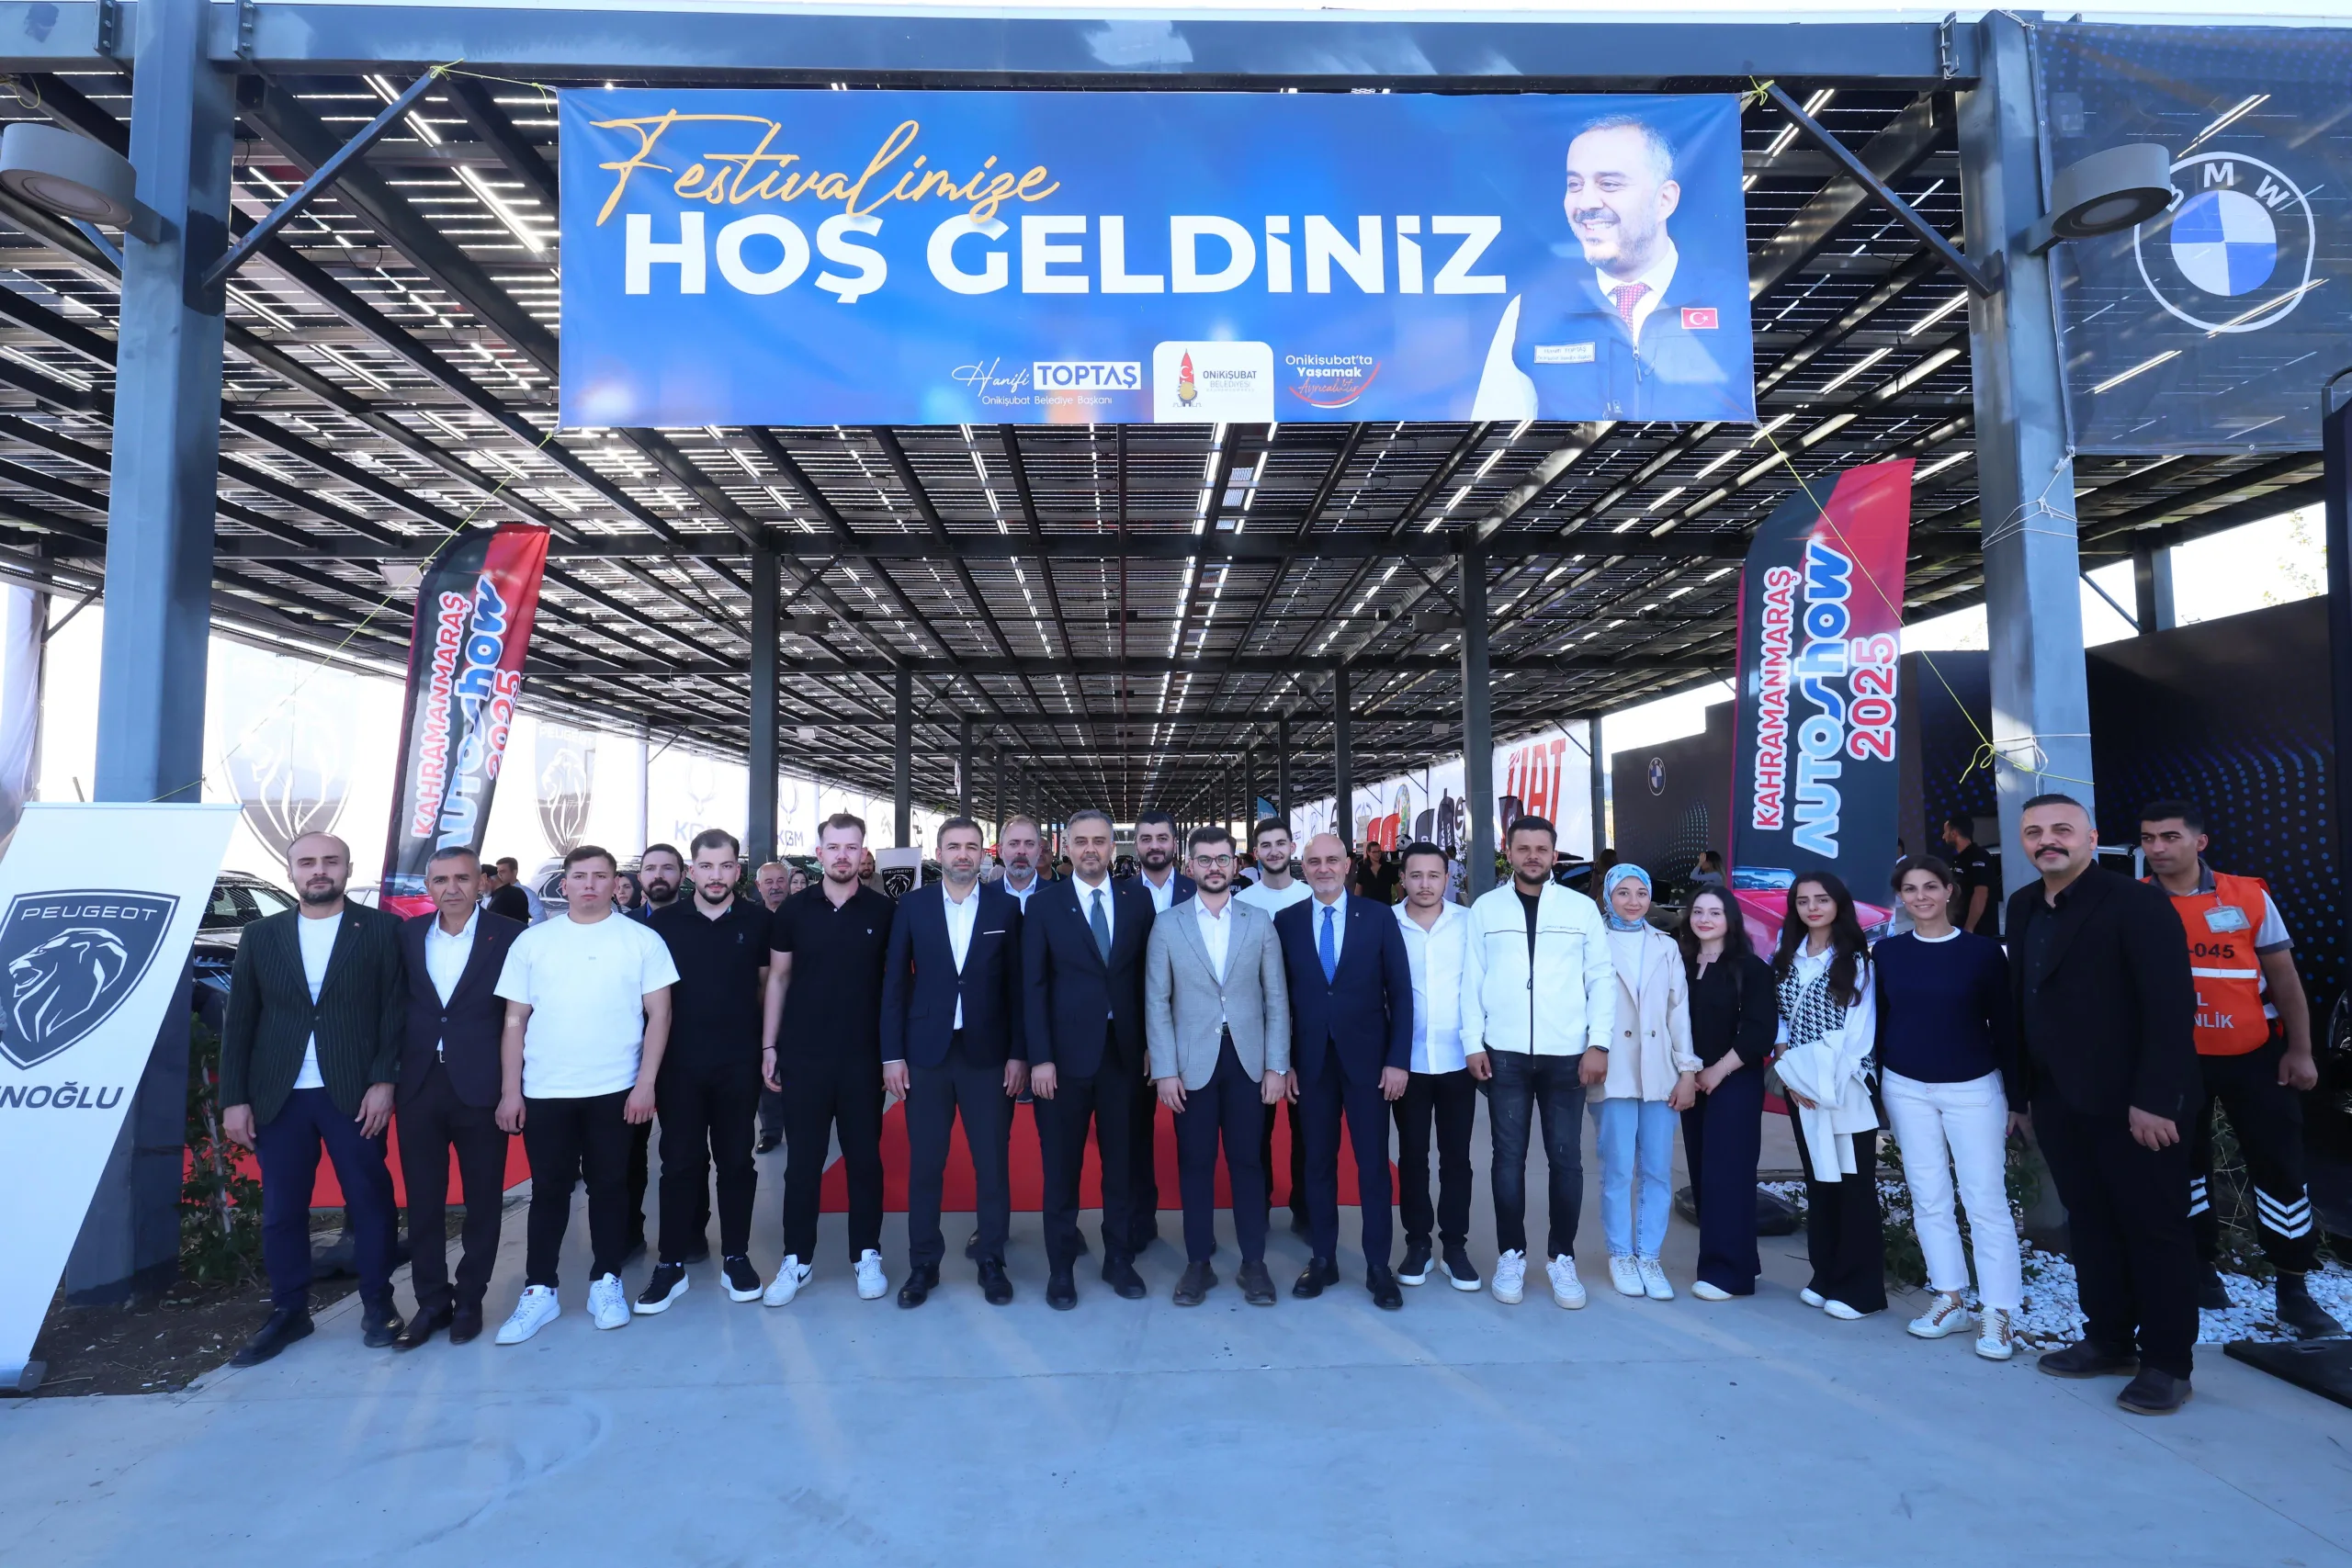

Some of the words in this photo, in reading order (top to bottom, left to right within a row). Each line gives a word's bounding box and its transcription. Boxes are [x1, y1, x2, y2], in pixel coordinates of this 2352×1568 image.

[589, 108, 1061, 227] Festivalimize
[625, 211, 888, 304] HOŞ
[927, 213, 1507, 295] GELDİNİZ
[951, 356, 1030, 397] Hanifi
[1036, 365, 1137, 389] TOPTAŞ
[1296, 367, 1362, 378] Yaşamak
[981, 396, 1031, 407] Onikişubat
[1035, 395, 1073, 406] Belediye
[1078, 395, 1113, 406] Başkanı
[411, 591, 472, 839] KAHRAMANMARAŞ
[1753, 566, 1802, 830] KAHRAMANMARAŞ
[1847, 633, 1898, 761] 2025
[21, 905, 158, 921] PEUGEOT
[2194, 1011, 2234, 1029] NLİK
[0, 1081, 125, 1109] NOĞLU
